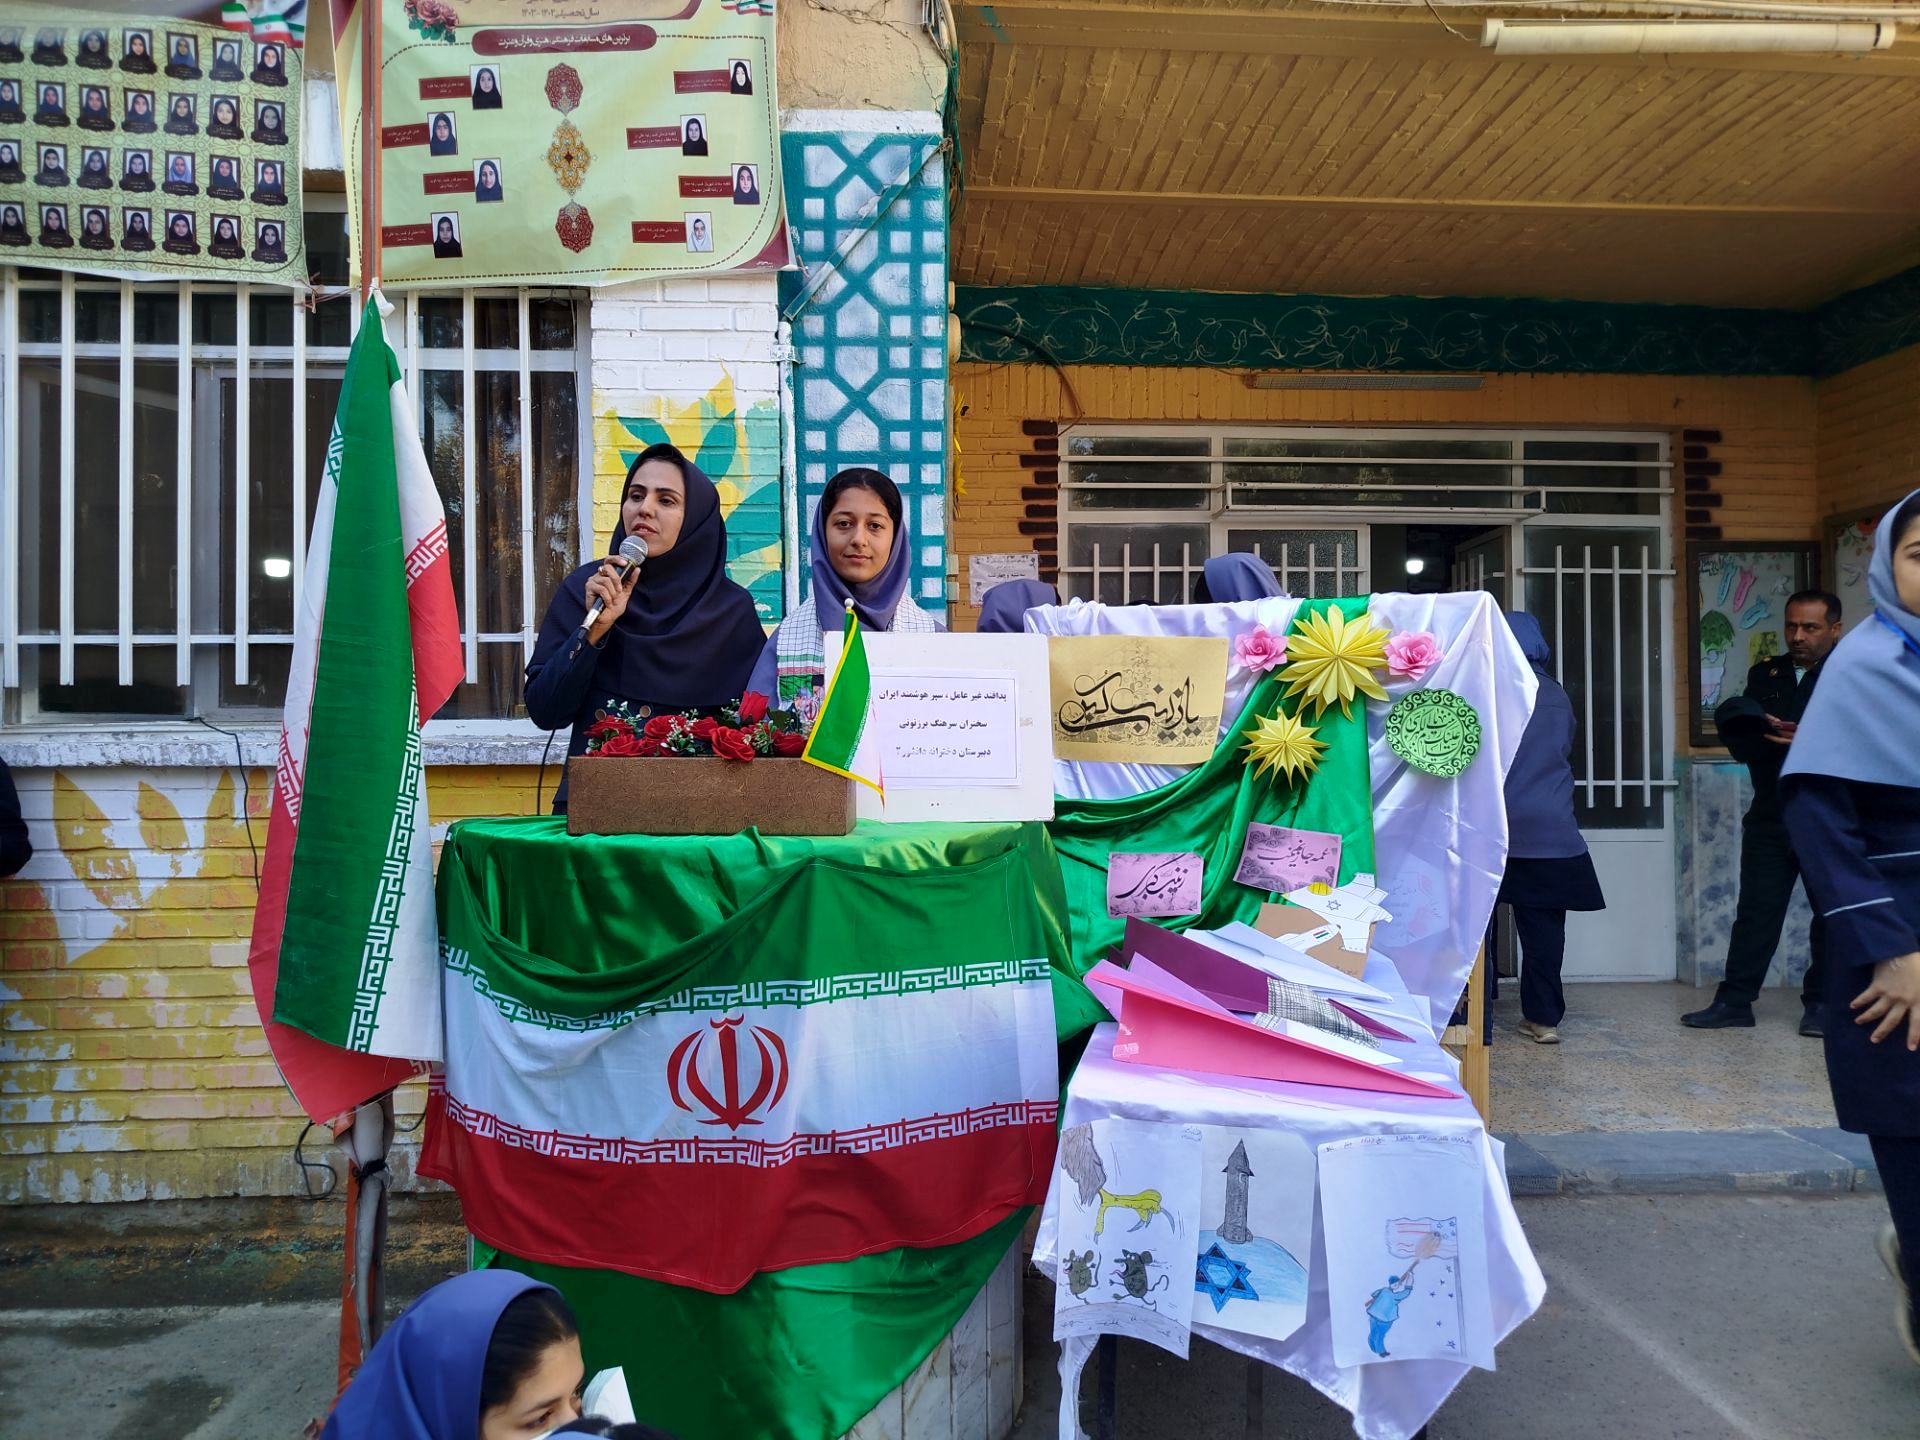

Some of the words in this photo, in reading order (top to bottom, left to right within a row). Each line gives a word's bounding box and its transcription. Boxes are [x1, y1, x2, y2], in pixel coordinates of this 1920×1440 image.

[879, 690, 899, 700] ایران
[901, 690, 929, 701] هوشمند
[930, 692, 943, 702] سپر
[950, 691, 968, 701] عامل
[971, 691, 982, 701] غیر
[984, 690, 1007, 702] پدافند
[930, 719, 957, 729] سرهنگ
[959, 720, 988, 730] سخنران
[958, 747, 991, 758] دبیرستان
